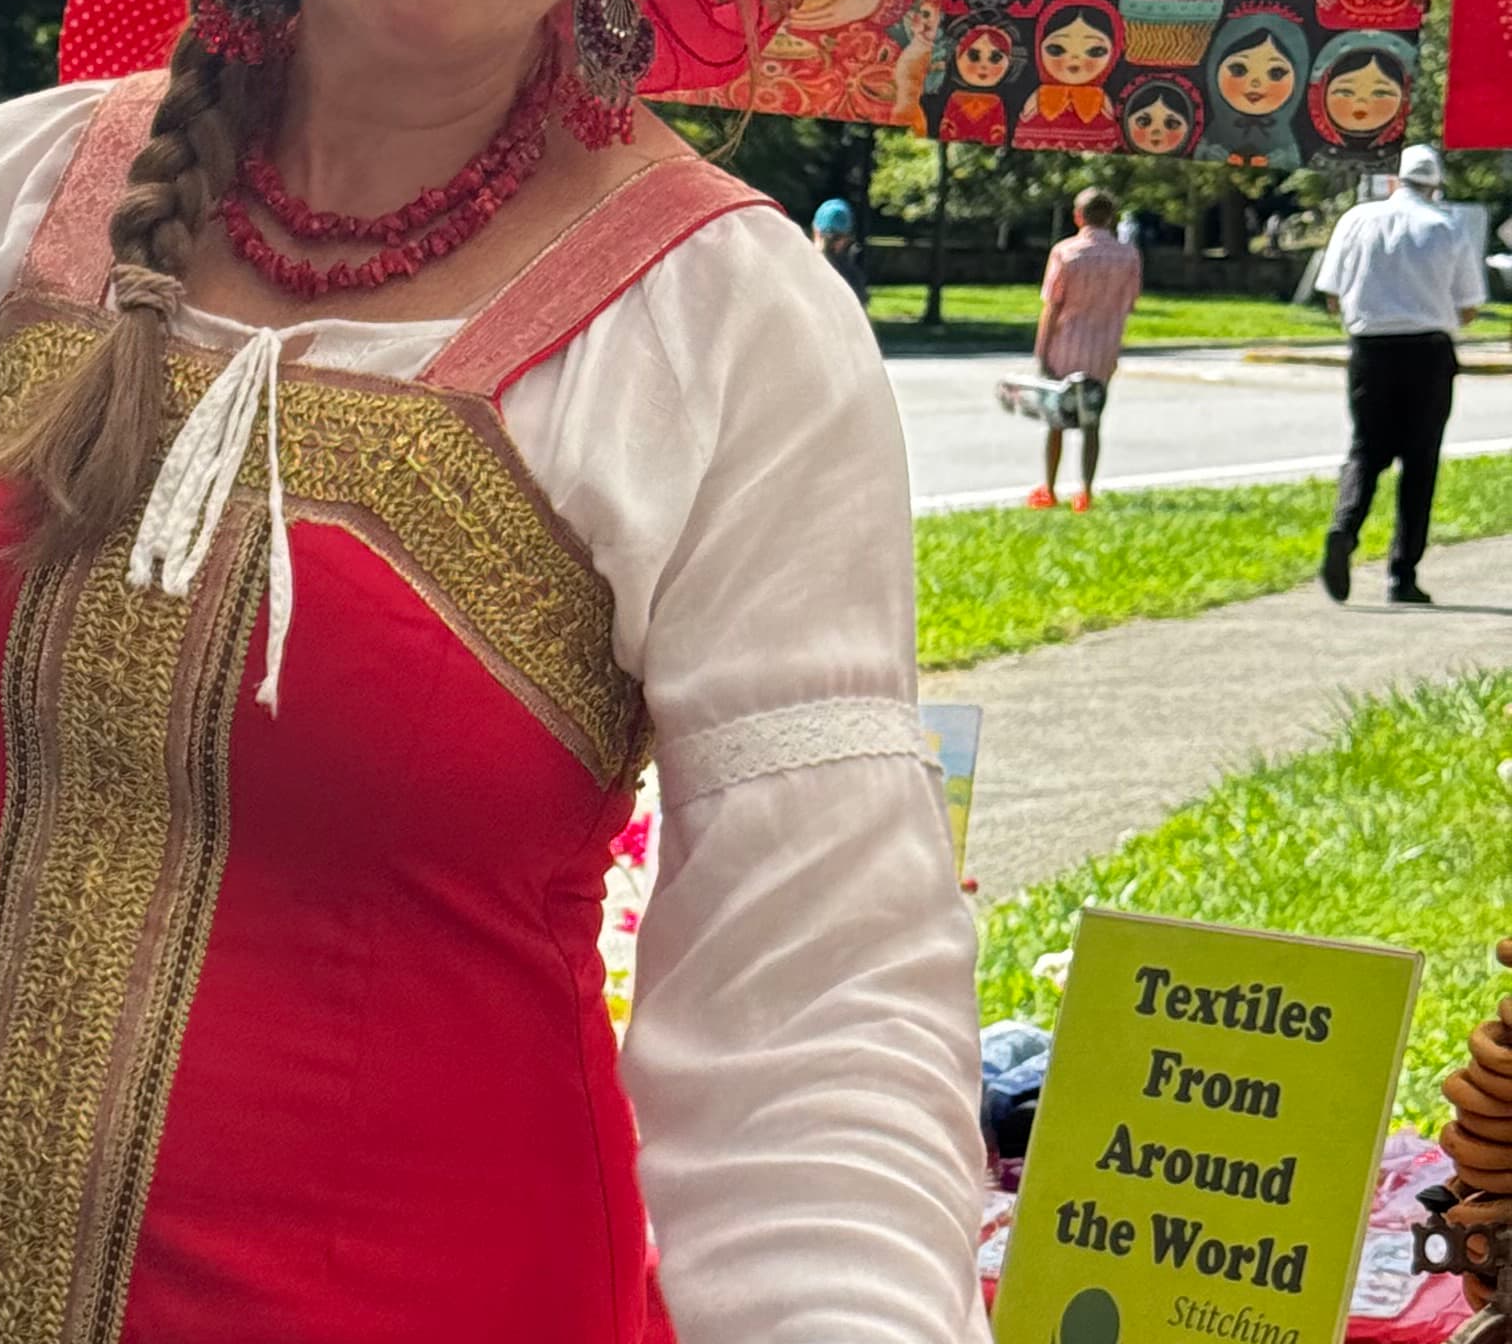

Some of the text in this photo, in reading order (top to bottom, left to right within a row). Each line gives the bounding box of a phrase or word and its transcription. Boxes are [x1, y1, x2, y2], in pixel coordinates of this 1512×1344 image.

[1134, 966, 1332, 1043] Textiles
[1142, 1048, 1280, 1118] From
[1095, 1123, 1297, 1205] Around
[1056, 1200, 1308, 1293] the World
